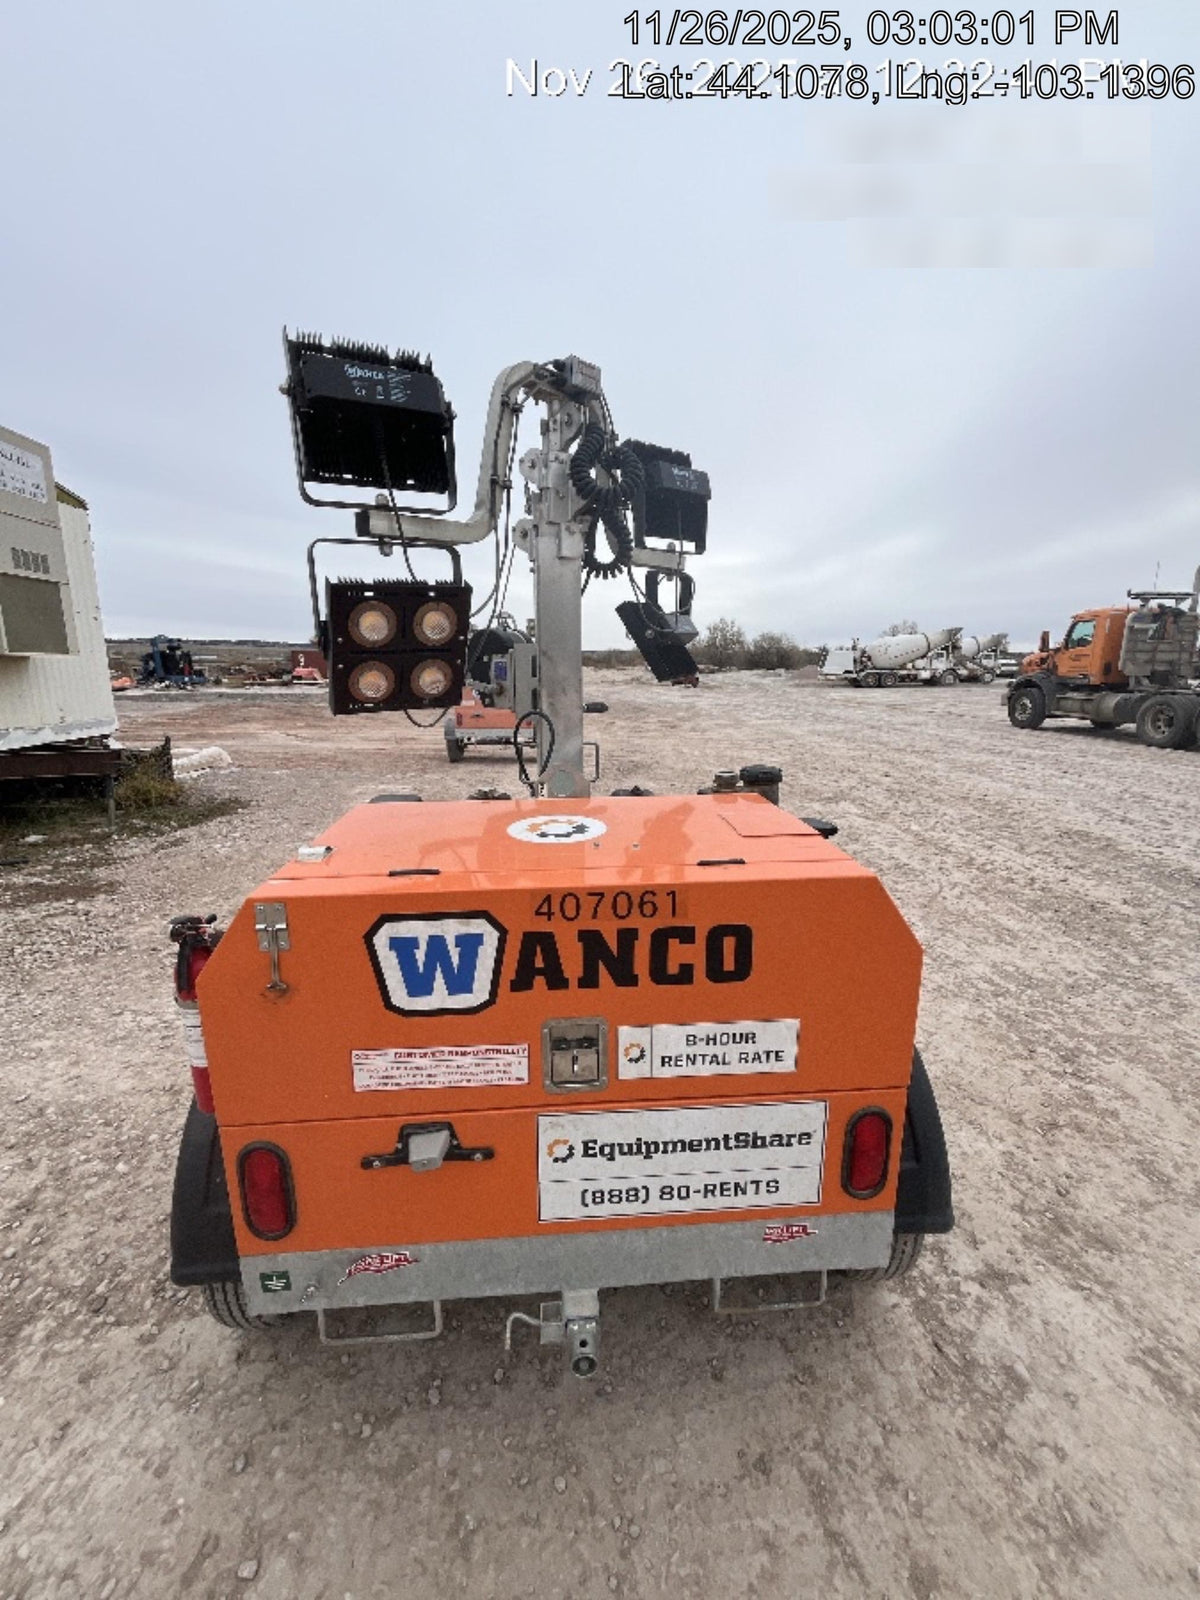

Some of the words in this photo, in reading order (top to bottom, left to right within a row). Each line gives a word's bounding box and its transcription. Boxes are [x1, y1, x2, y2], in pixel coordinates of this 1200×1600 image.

[534, 890, 678, 921] 407061
[388, 924, 753, 997] WANCO
[660, 1052, 731, 1067] RENTAL
[738, 1050, 785, 1064] RATE
[580, 1130, 814, 1161] EquipmentShare
[580, 1185, 650, 1207] (888)
[658, 1179, 780, 1201] 80-RENTS
